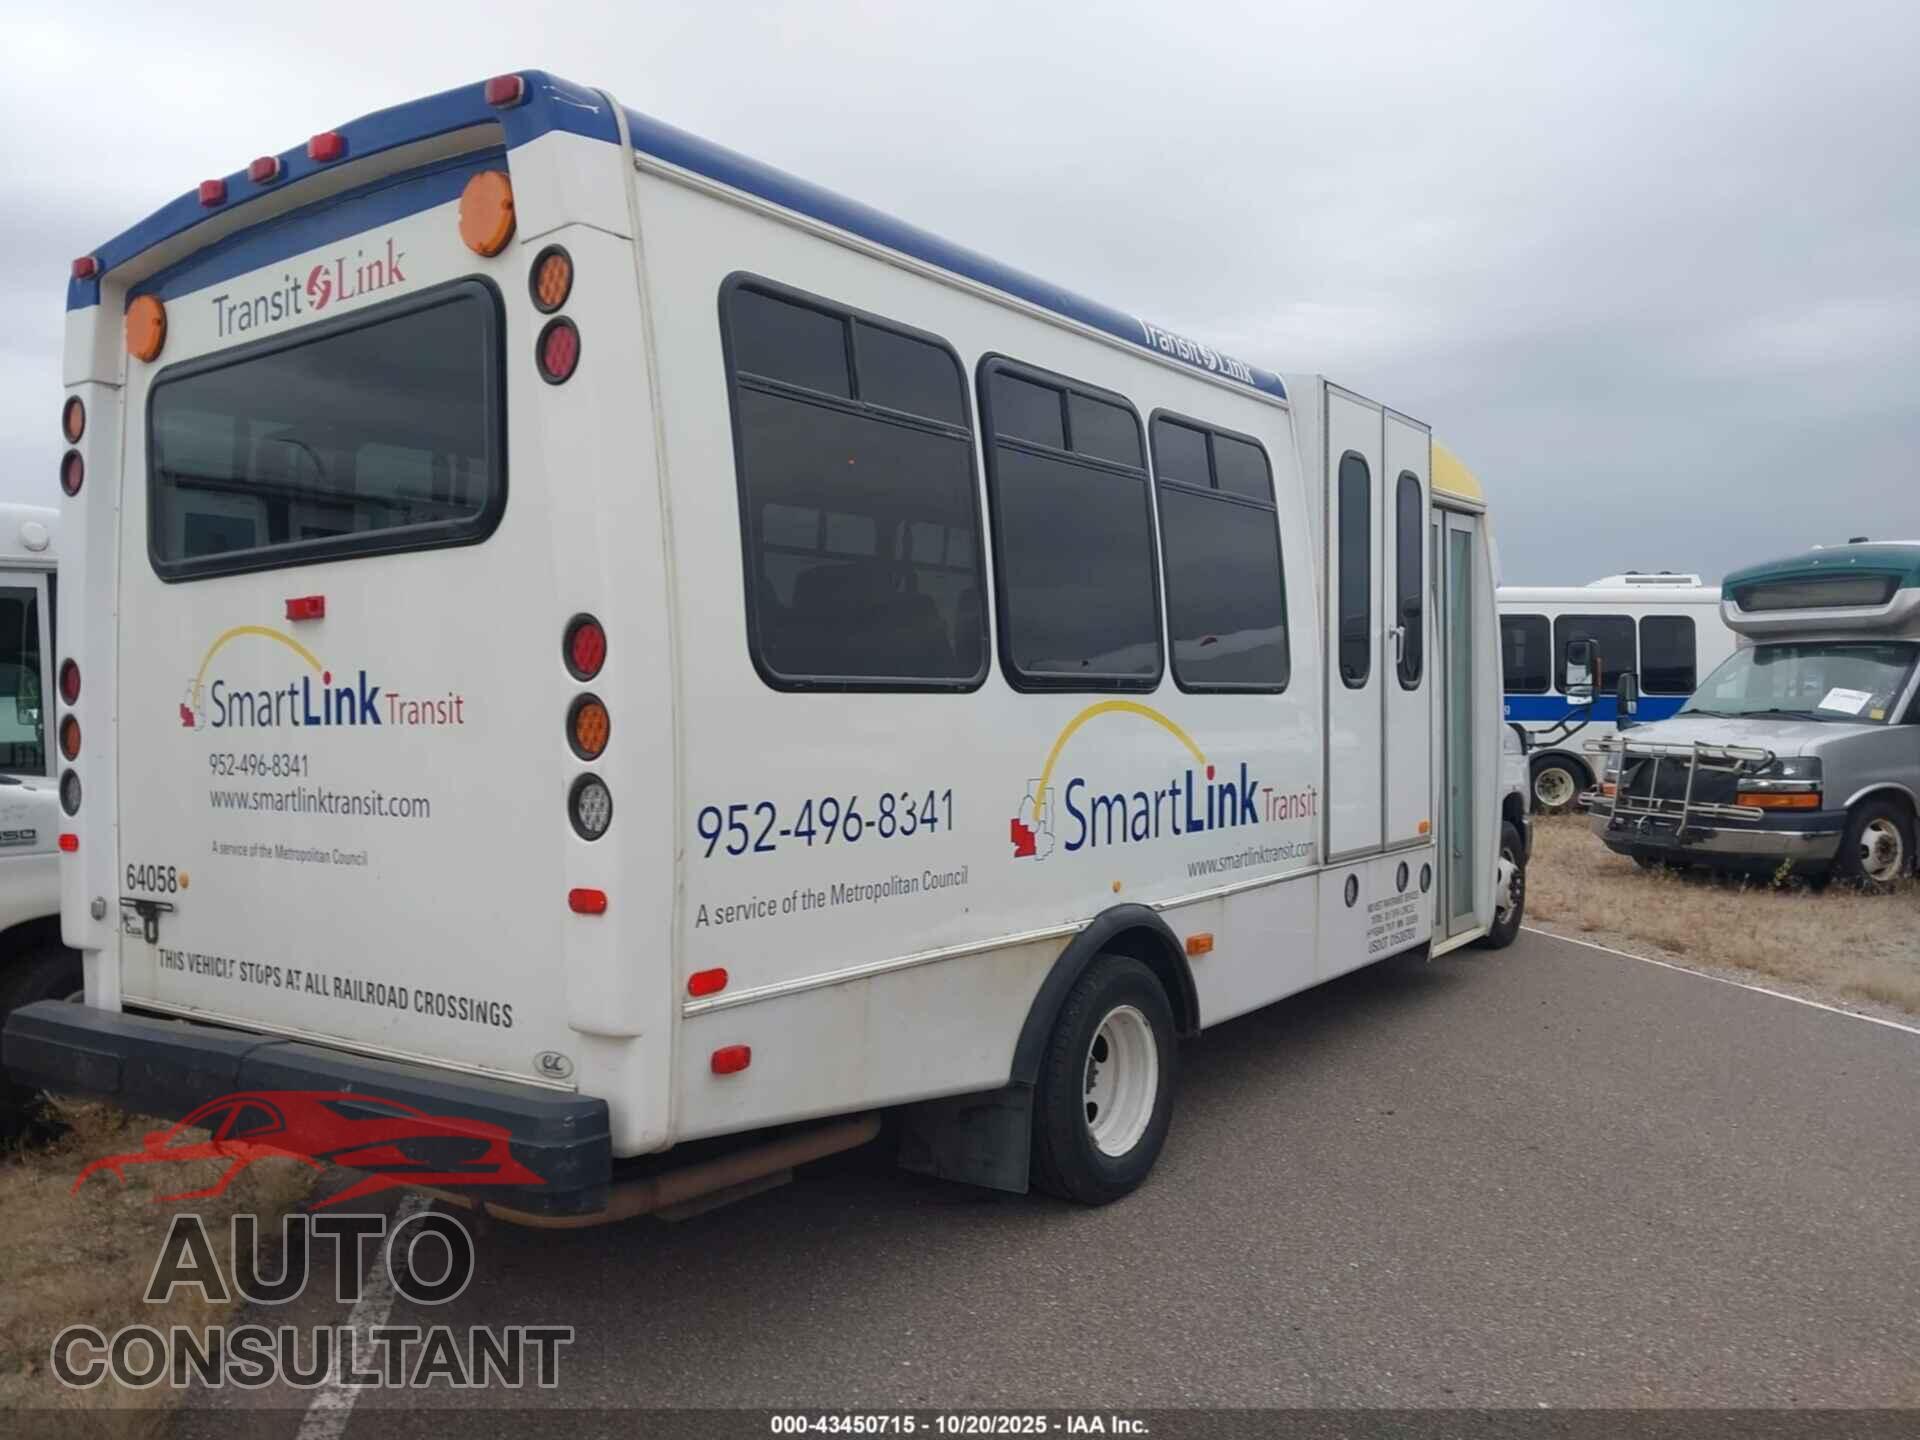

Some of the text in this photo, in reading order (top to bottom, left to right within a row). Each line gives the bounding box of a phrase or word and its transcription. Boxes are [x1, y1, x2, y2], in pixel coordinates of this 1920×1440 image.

[212, 237, 409, 337] Transit Link
[210, 670, 465, 728] SmartLink Transit
[209, 753, 309, 777] 952-496-8341
[209, 786, 431, 818] www.smartlinktransit.com
[697, 788, 953, 858] 952-496-8341
[1064, 762, 1318, 852] SmartLink Transit
[126, 863, 177, 893] 64058
[211, 839, 218, 853] A
[219, 843, 248, 857] service
[260, 843, 273, 858] the
[274, 845, 331, 864] Metropolitan
[333, 848, 368, 866] Council
[695, 865, 969, 928] A service of the Metropolitan Council
[158, 948, 184, 971] THIS
[240, 961, 281, 988] STOPS
[285, 969, 302, 992] AT
[304, 972, 330, 996] ALL
[333, 976, 408, 1010] RAILROAD
[413, 989, 513, 1028] CROSSINGS
